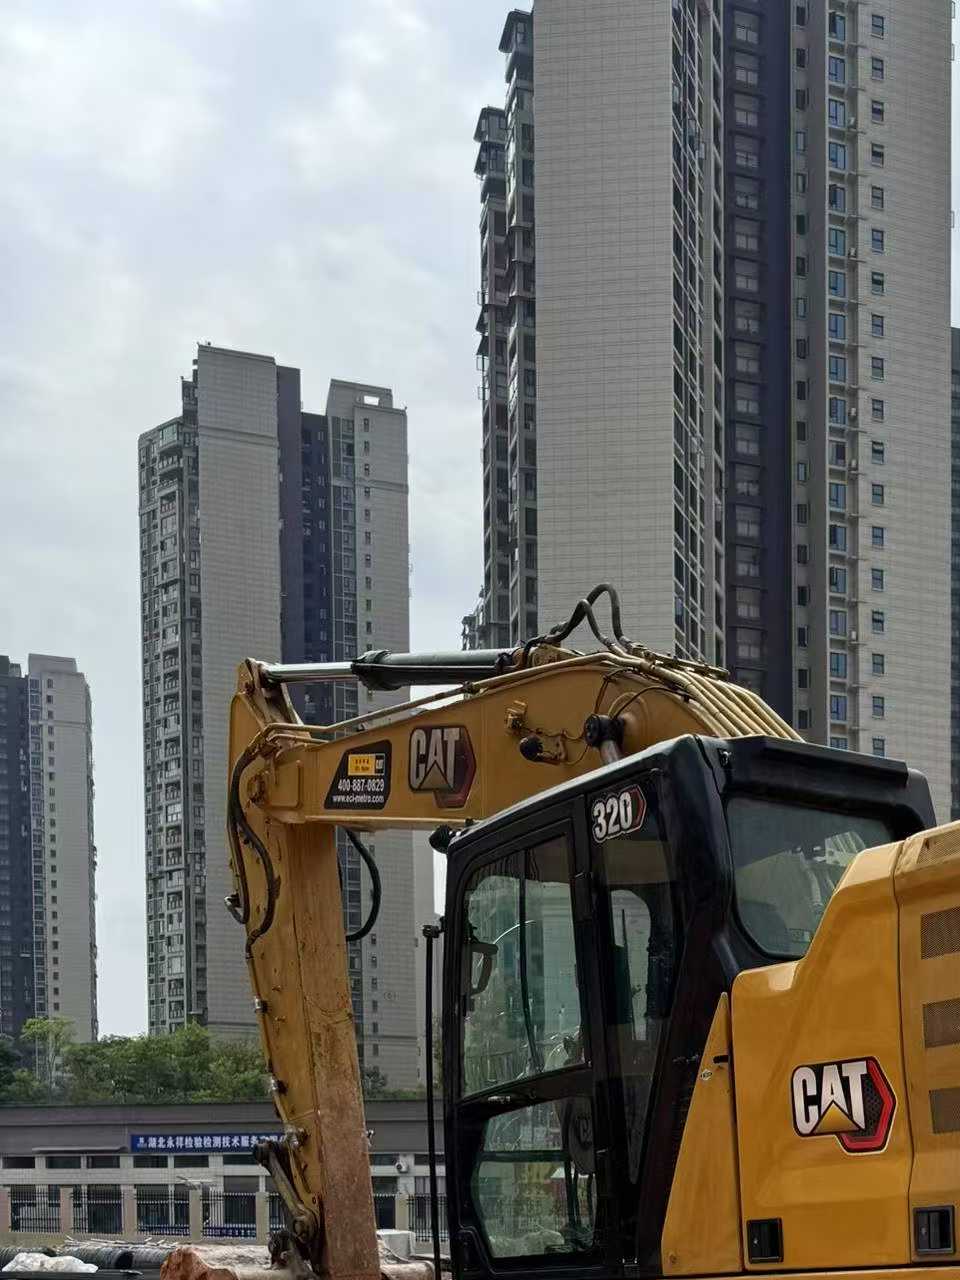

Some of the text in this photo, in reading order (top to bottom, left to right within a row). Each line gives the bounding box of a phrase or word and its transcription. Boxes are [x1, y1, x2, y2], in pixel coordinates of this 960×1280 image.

[411, 727, 459, 790] CAT
[593, 794, 633, 840] 320
[793, 1060, 867, 1135] CAT
[148, 1135, 286, 1149] 湖北永祥检验检测技术服务
